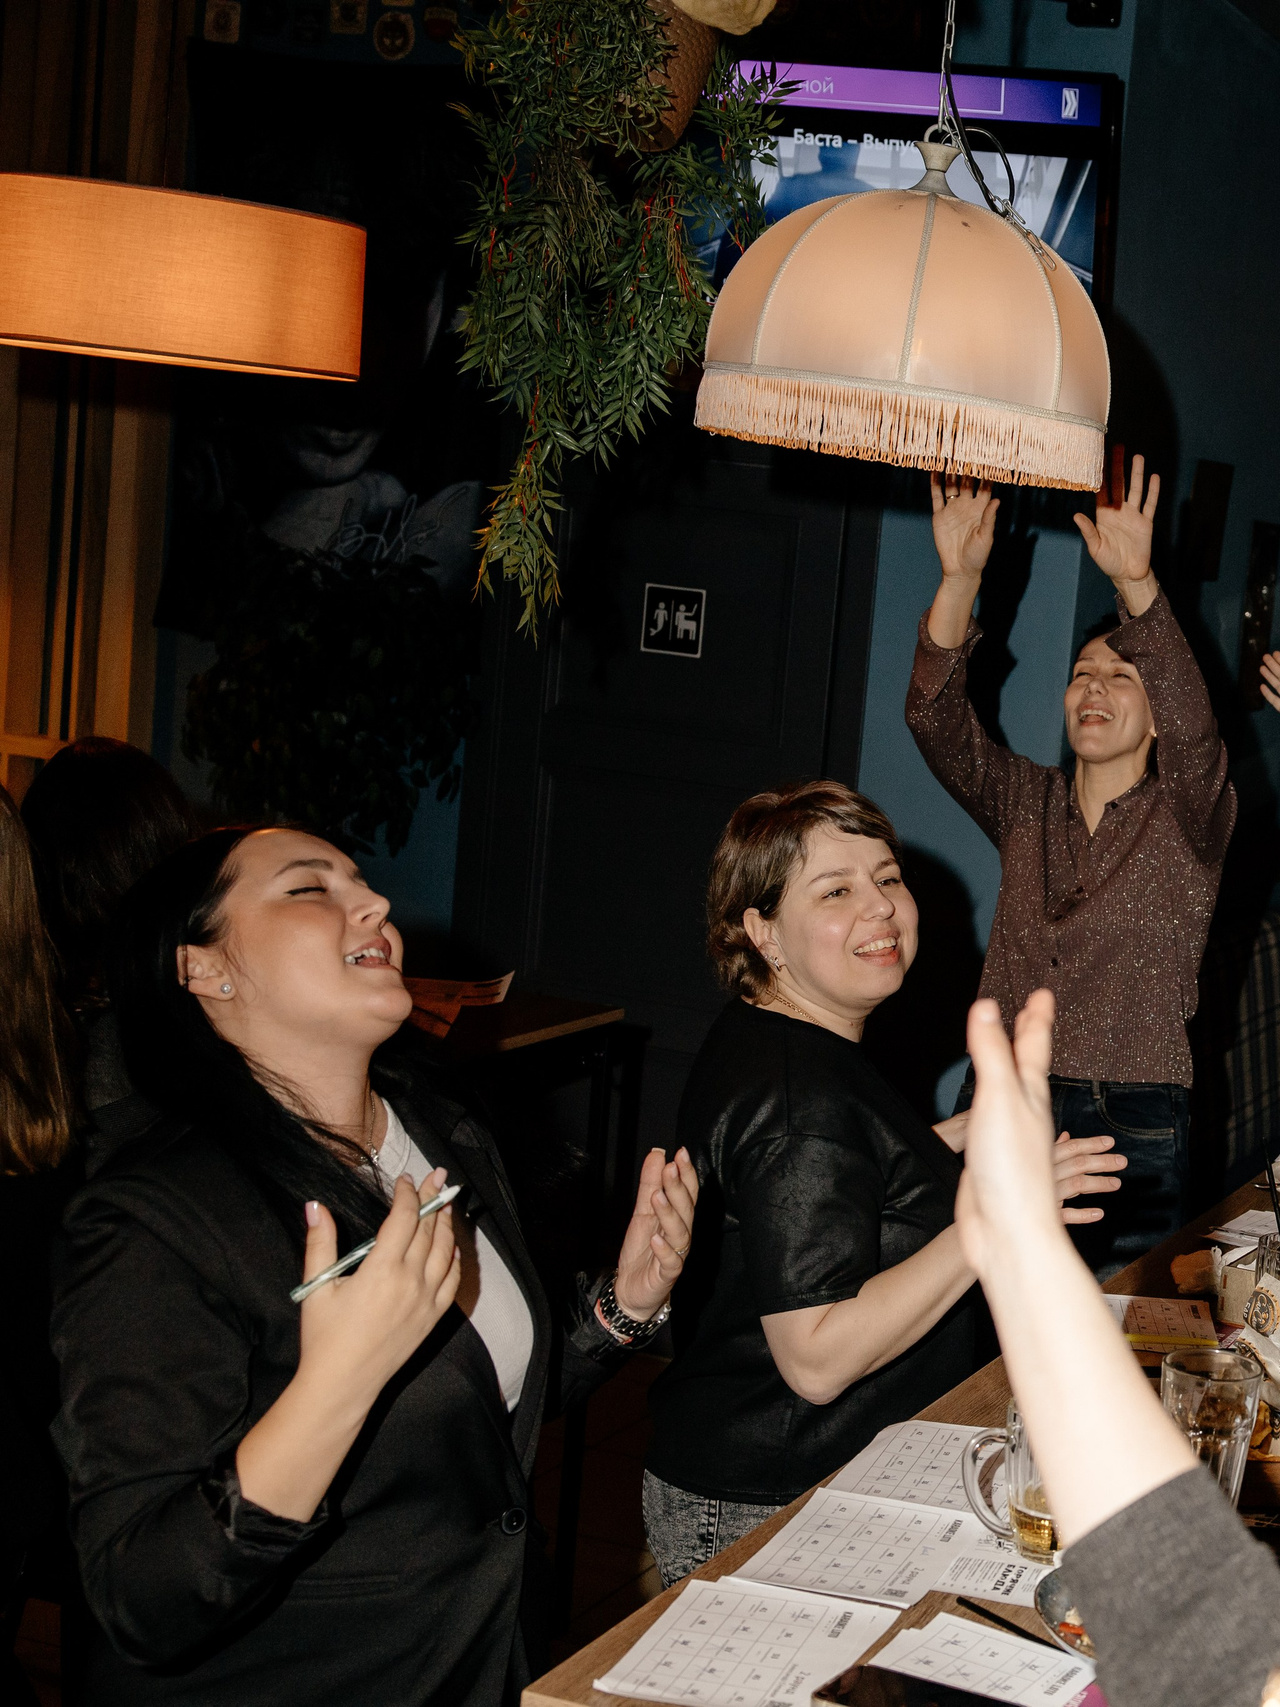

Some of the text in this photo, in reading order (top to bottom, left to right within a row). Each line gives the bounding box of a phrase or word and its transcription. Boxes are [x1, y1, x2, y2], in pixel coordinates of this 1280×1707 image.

[793, 128, 843, 148] Баста
[863, 133, 918, 155] Выпус
[991, 1564, 1015, 1591] БЛЮДА
[1001, 1567, 1027, 1596] ГОРЯЧИЕ
